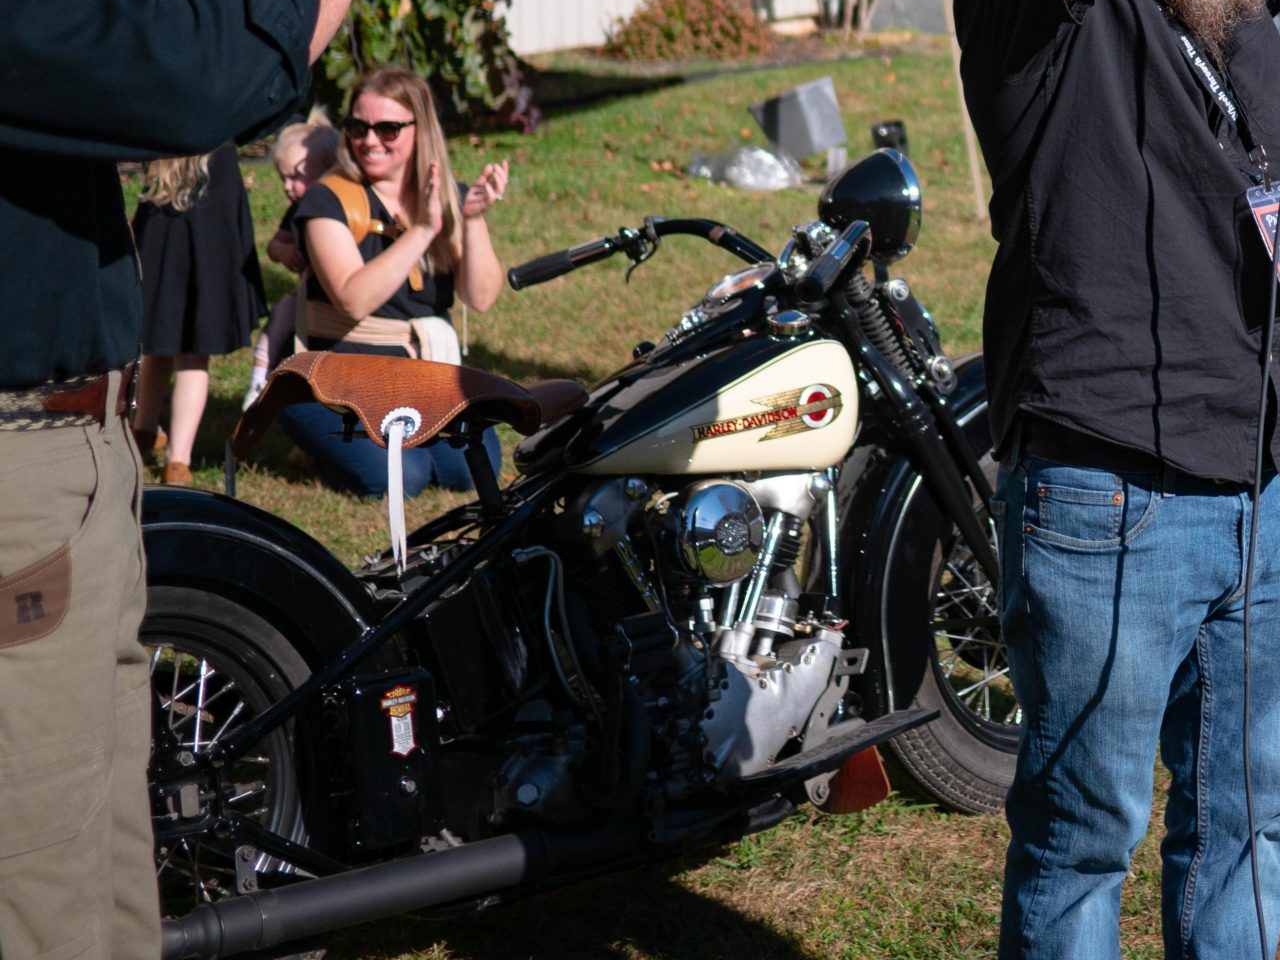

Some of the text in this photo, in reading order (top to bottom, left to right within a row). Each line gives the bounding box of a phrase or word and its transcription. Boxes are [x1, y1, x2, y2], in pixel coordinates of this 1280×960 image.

[1180, 35, 1197, 58] Time
[1194, 56, 1220, 93] Through
[697, 406, 799, 439] HARLEY-DAVIDSON
